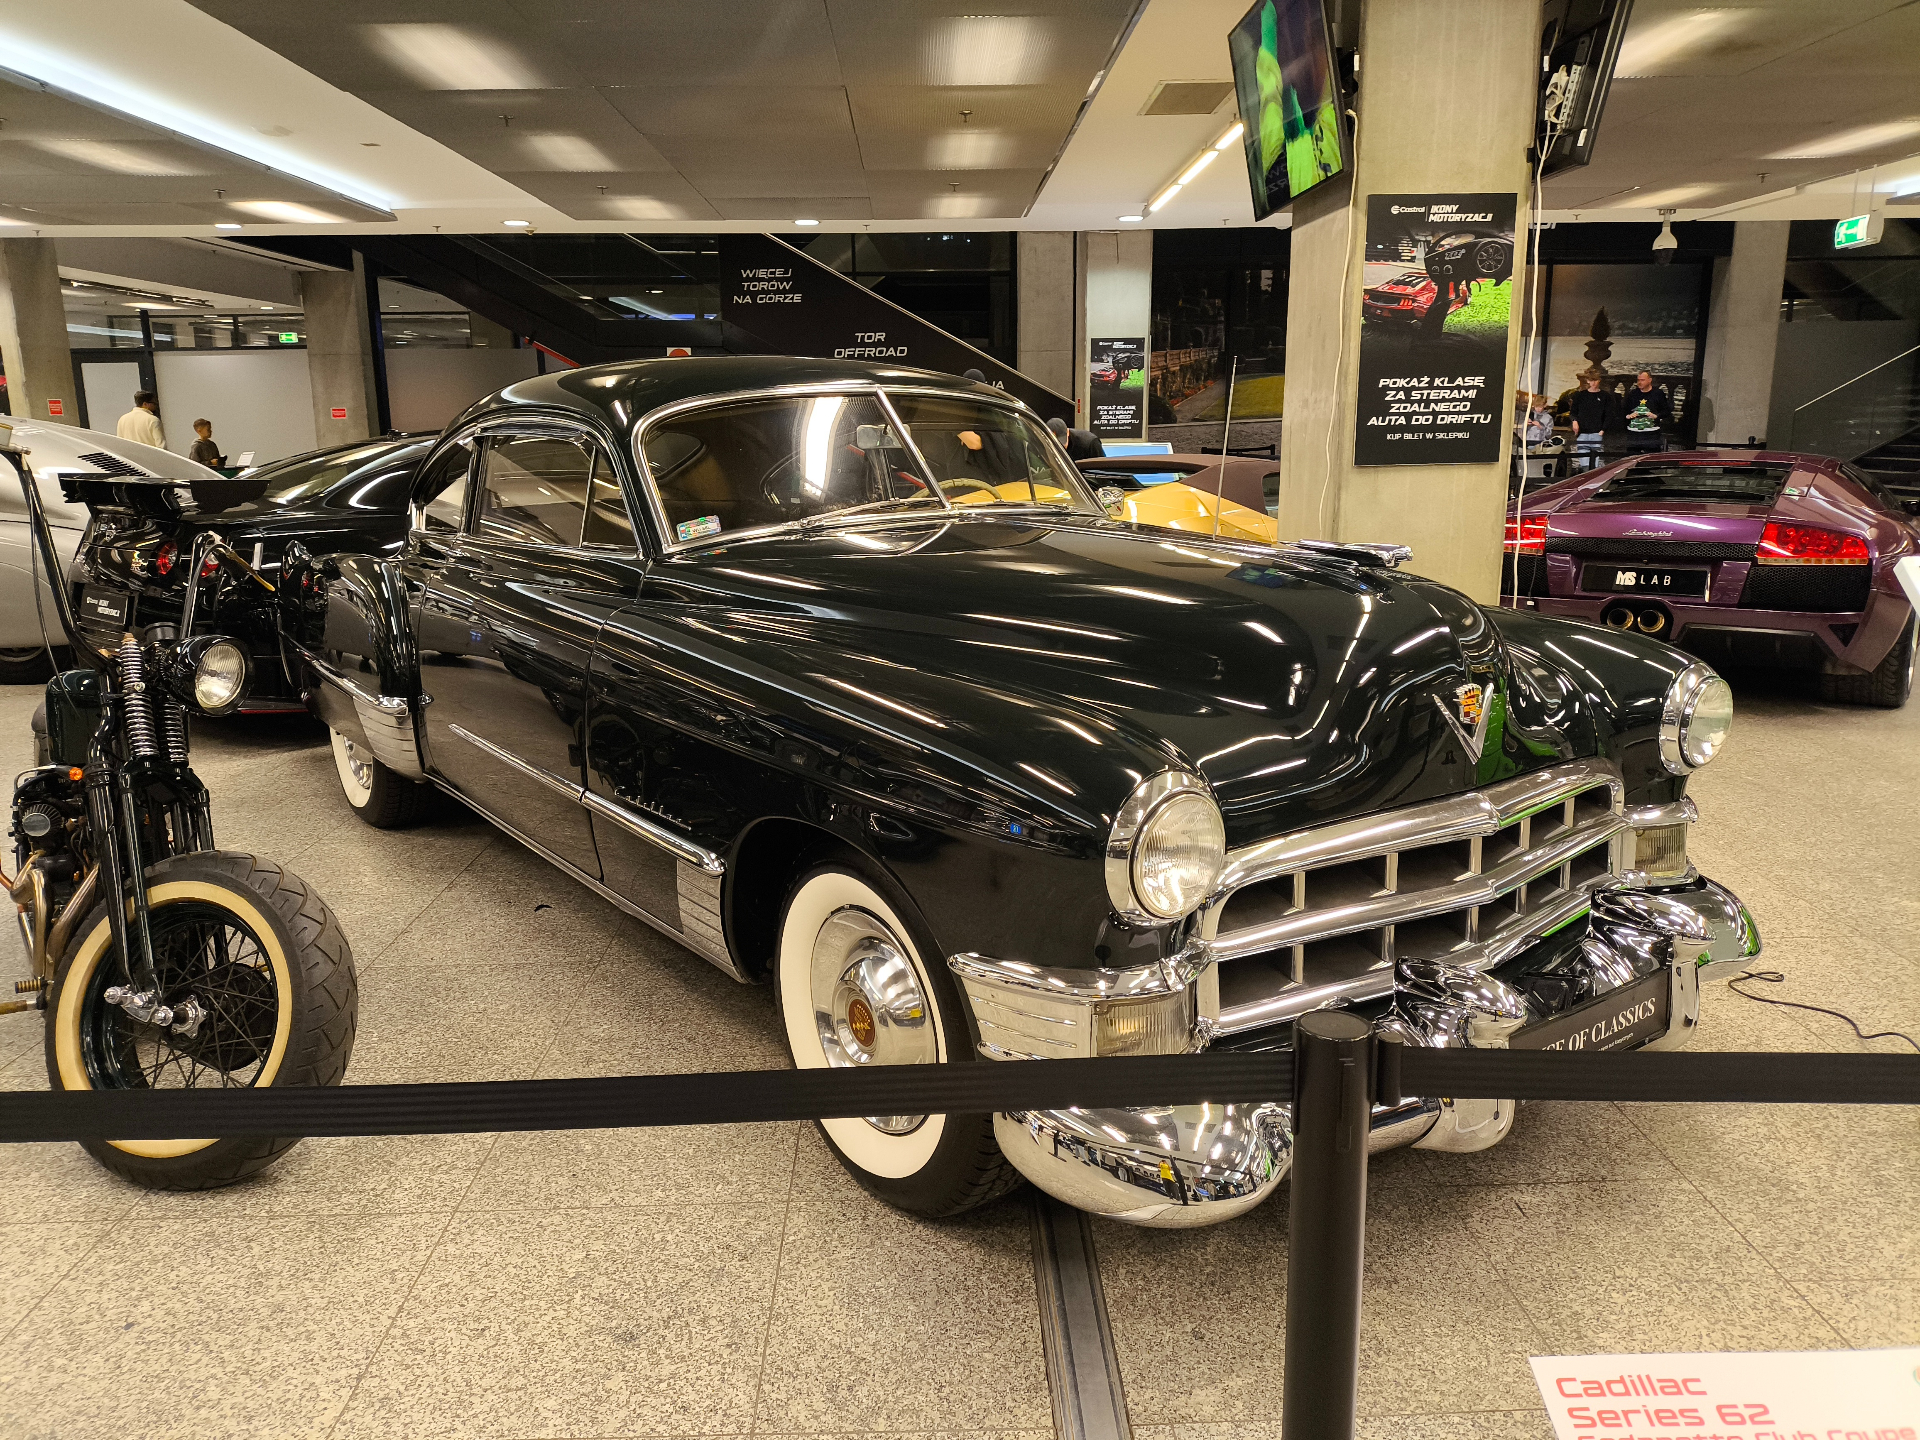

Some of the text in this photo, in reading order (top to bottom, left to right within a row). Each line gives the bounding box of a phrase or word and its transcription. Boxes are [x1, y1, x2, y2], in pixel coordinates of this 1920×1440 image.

[1430, 205, 1459, 213] IKONY
[1429, 213, 1493, 222] MOTORYZACJI
[741, 268, 792, 279] WIĘCEJ
[742, 280, 792, 291] TORÓW
[733, 293, 802, 304] NA GÓRZE
[855, 332, 886, 343] TOR
[834, 346, 907, 359] OFFROAD
[1378, 375, 1485, 388] POKAŻ KLASĘ
[1384, 389, 1477, 400] ZA STERAMI
[1389, 402, 1471, 413] ZDALNEGO
[1367, 414, 1492, 426] AUTA DO DRIFTU
[1403, 432, 1423, 440] BILET
[1616, 570, 1637, 585] MS
[1568, 997, 1656, 1051] OF CLASSICS
[1555, 1374, 1708, 1399] Cadillac
[1567, 1404, 1776, 1429] Series 62
